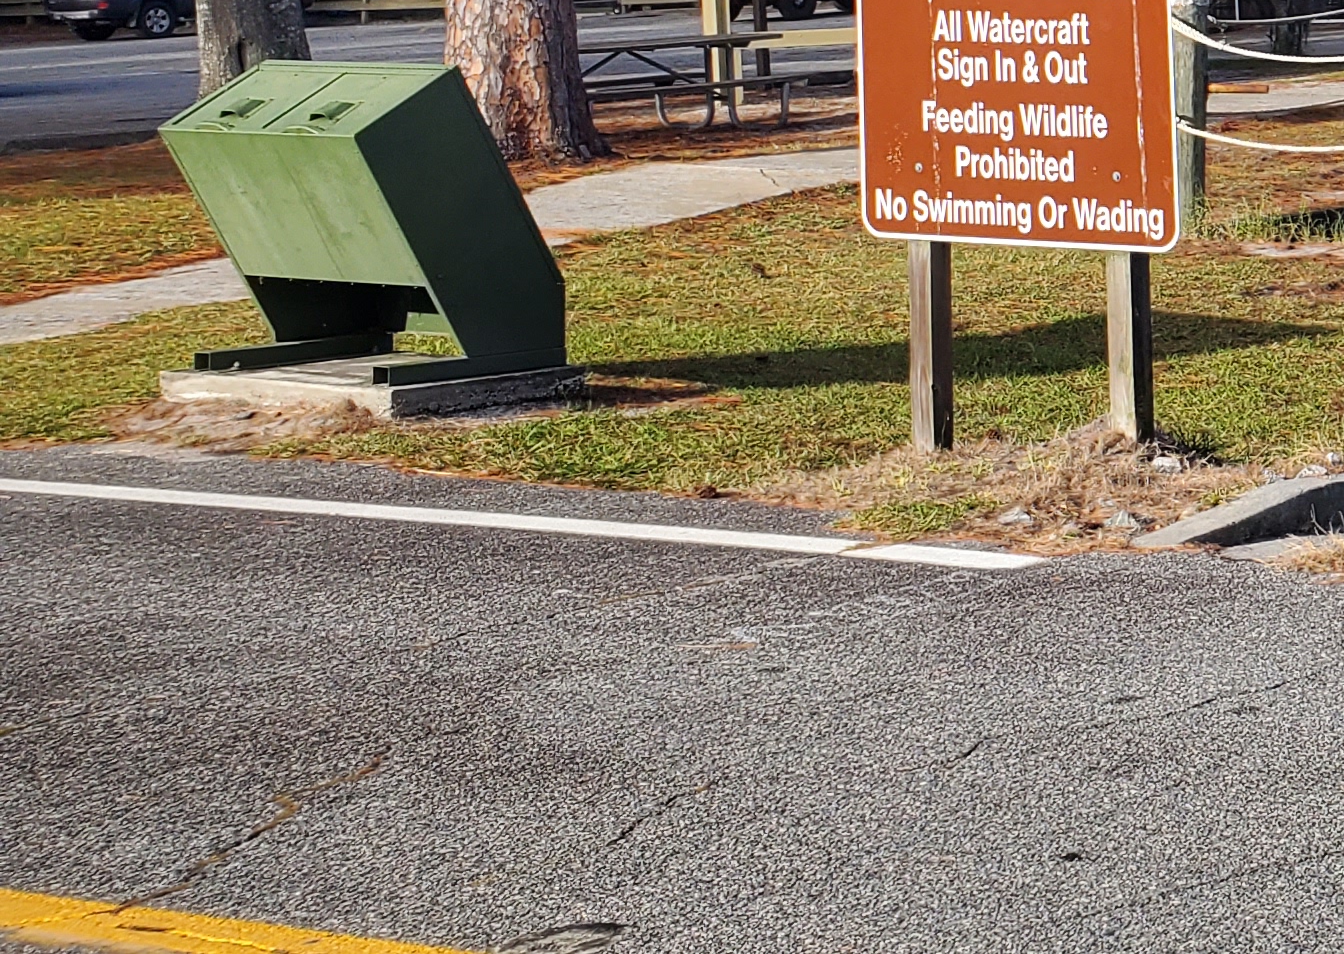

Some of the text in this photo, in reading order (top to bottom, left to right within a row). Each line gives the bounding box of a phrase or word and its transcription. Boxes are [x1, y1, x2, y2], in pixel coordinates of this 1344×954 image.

[933, 10, 1090, 45] All Watercraft
[937, 49, 1088, 87] Sign In & Out
[921, 100, 1108, 142] Feeding Wildlife
[955, 145, 1075, 183] Prohibited
[875, 188, 1165, 241] No Swimming Or Wading
